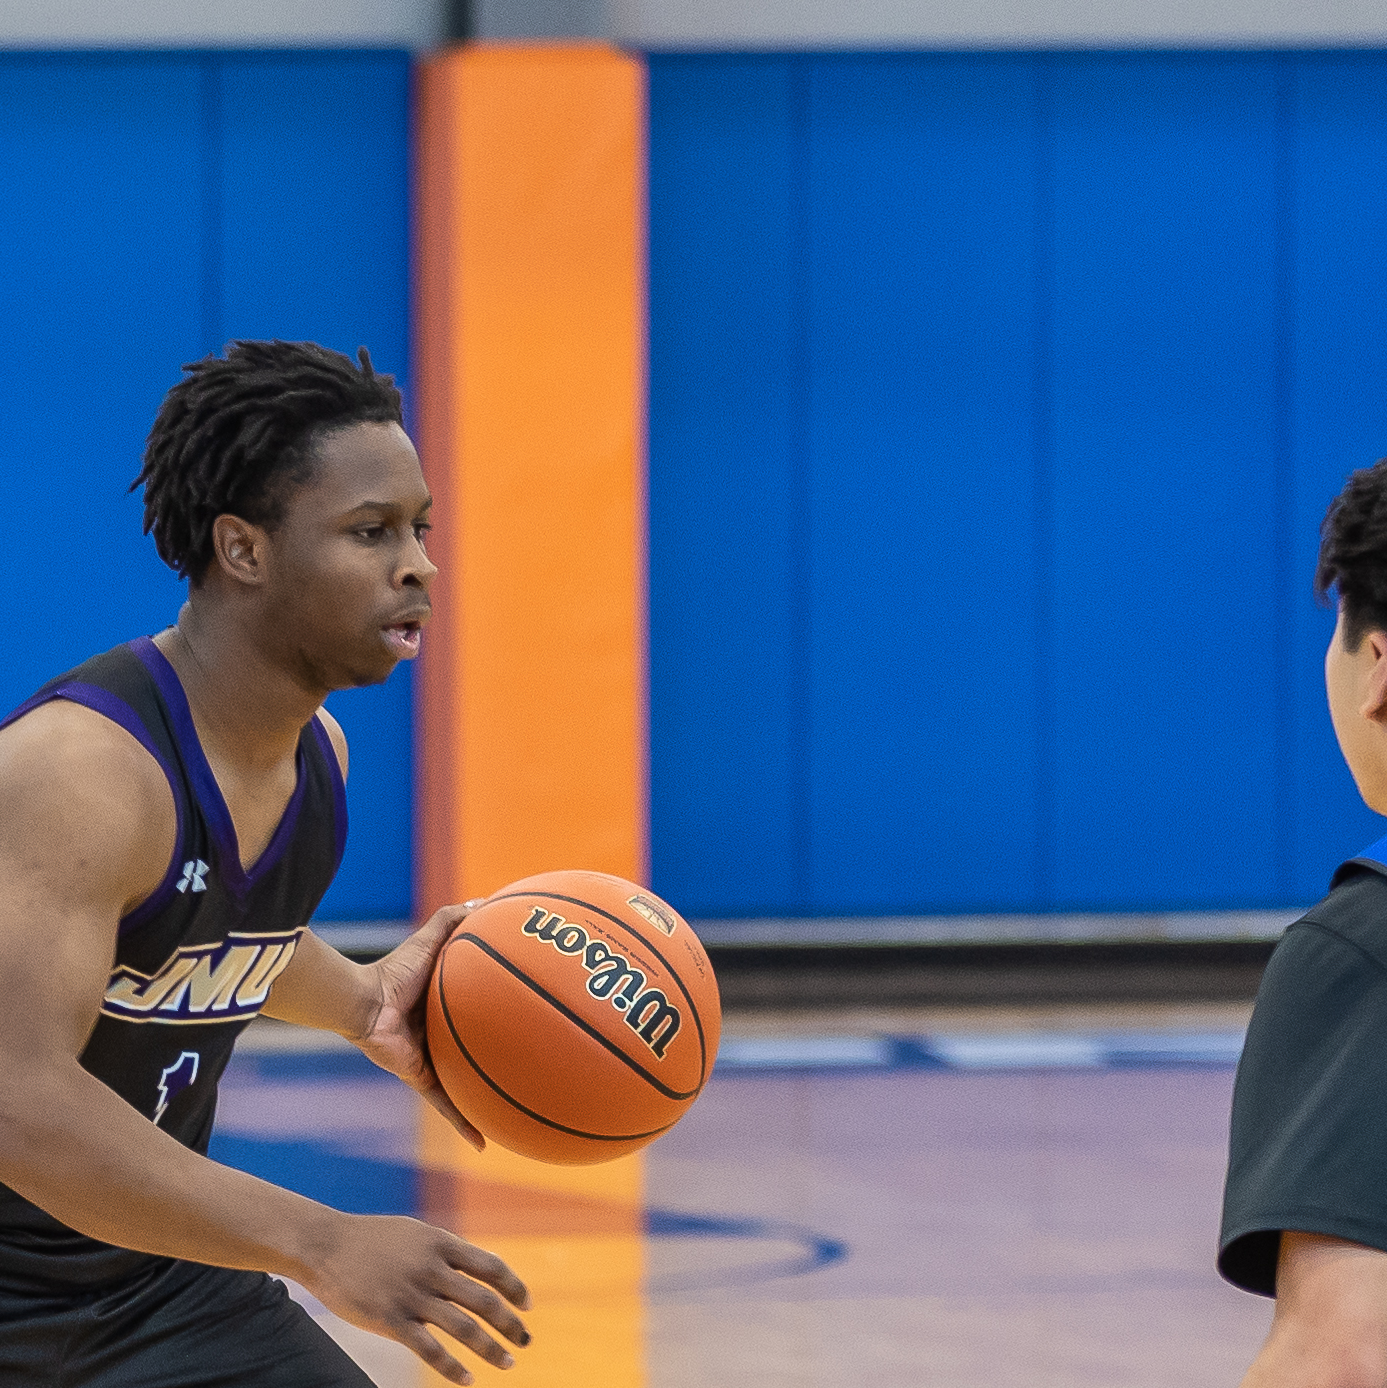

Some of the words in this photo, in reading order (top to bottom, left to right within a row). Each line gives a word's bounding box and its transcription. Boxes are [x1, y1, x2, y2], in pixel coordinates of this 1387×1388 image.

[102, 935, 299, 1014] JMU
[520, 905, 682, 1063] Wilson
[153, 1050, 200, 1126] 1
